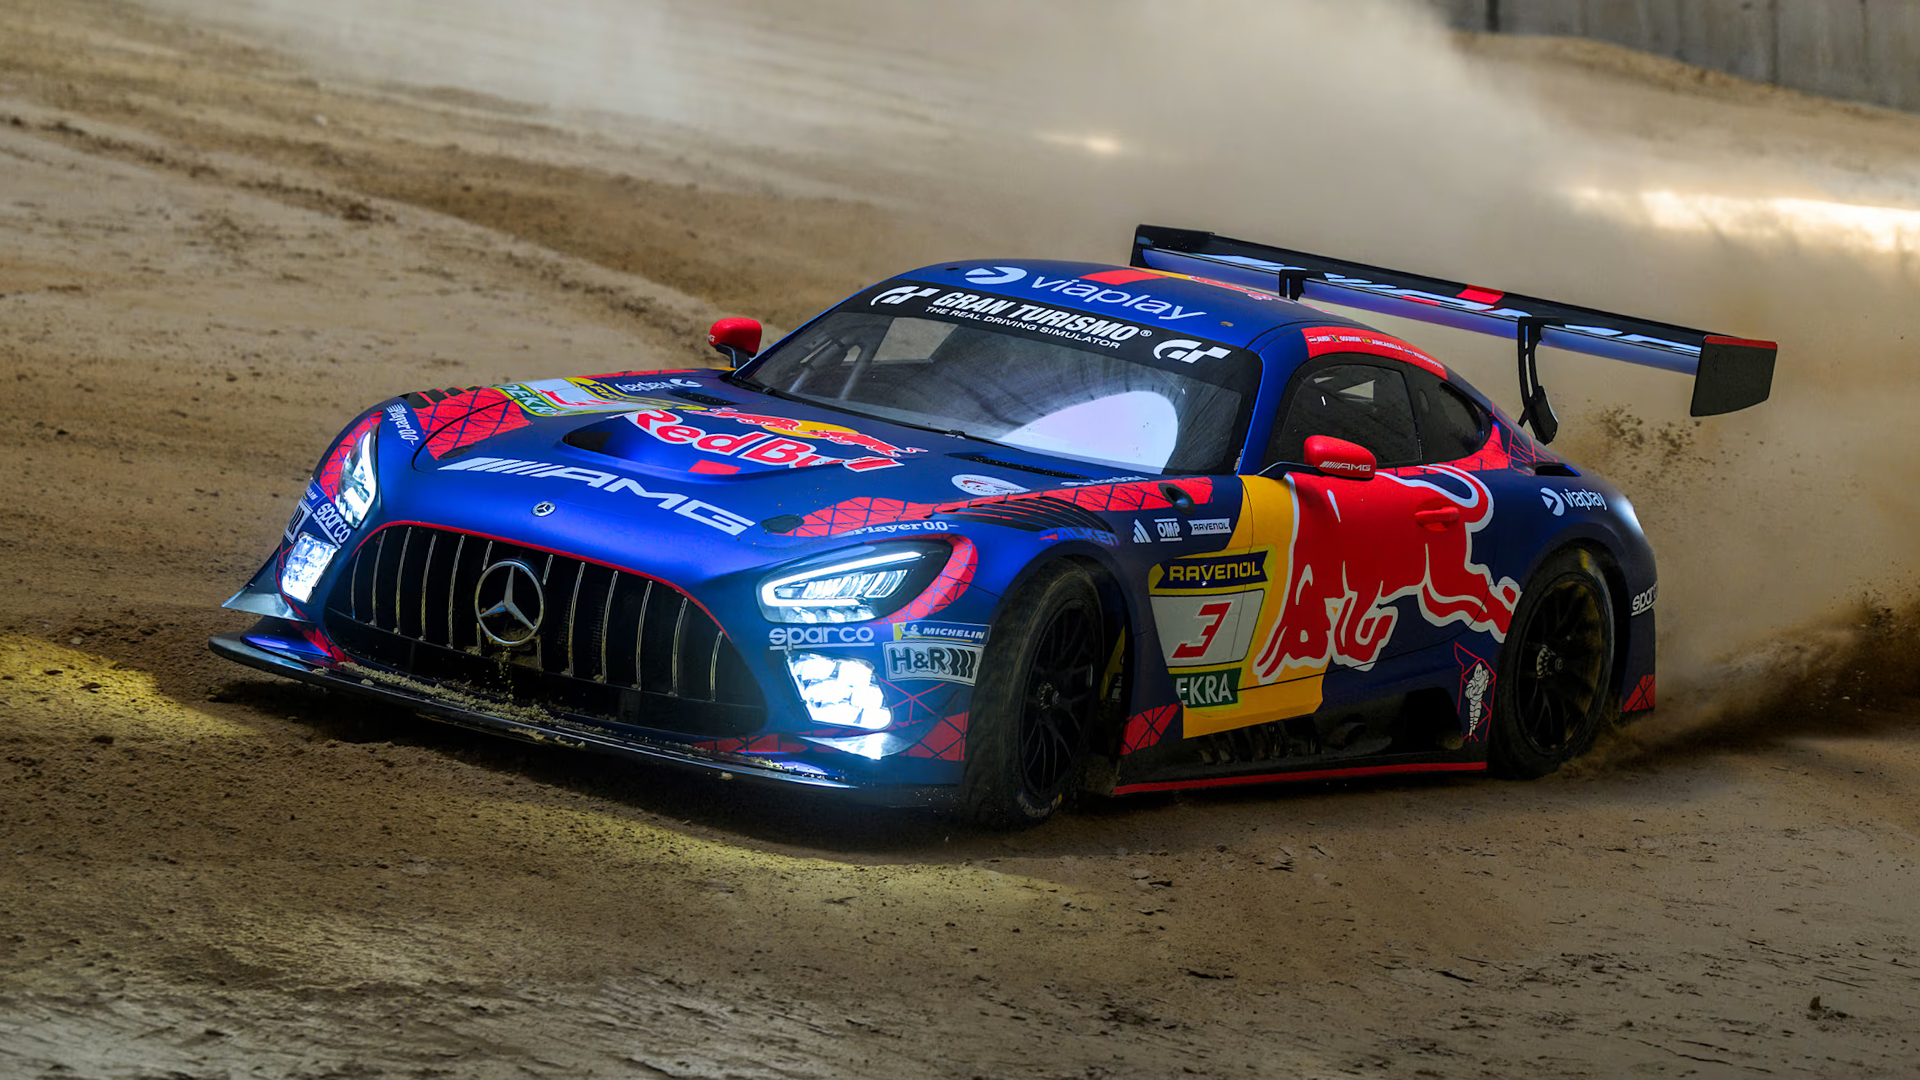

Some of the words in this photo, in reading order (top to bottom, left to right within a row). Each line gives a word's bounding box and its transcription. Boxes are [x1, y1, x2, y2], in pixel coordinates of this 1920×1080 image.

[932, 292, 1013, 316] GRAN
[1031, 275, 1207, 320] viaplay
[924, 305, 949, 315] THE
[949, 308, 981, 321] REAL
[982, 315, 1037, 331] DRIVING
[1038, 325, 1121, 350] SIMULATOR
[624, 408, 774, 456] Red
[515, 464, 756, 536] AMG
[1560, 488, 1607, 511] viaplay
[316, 502, 351, 544] sparco
[1156, 522, 1181, 537] OMP
[769, 626, 874, 649] sparco
[922, 626, 985, 639] MICHELIN
[1171, 600, 1232, 659] 3
[889, 648, 949, 675] H&R
